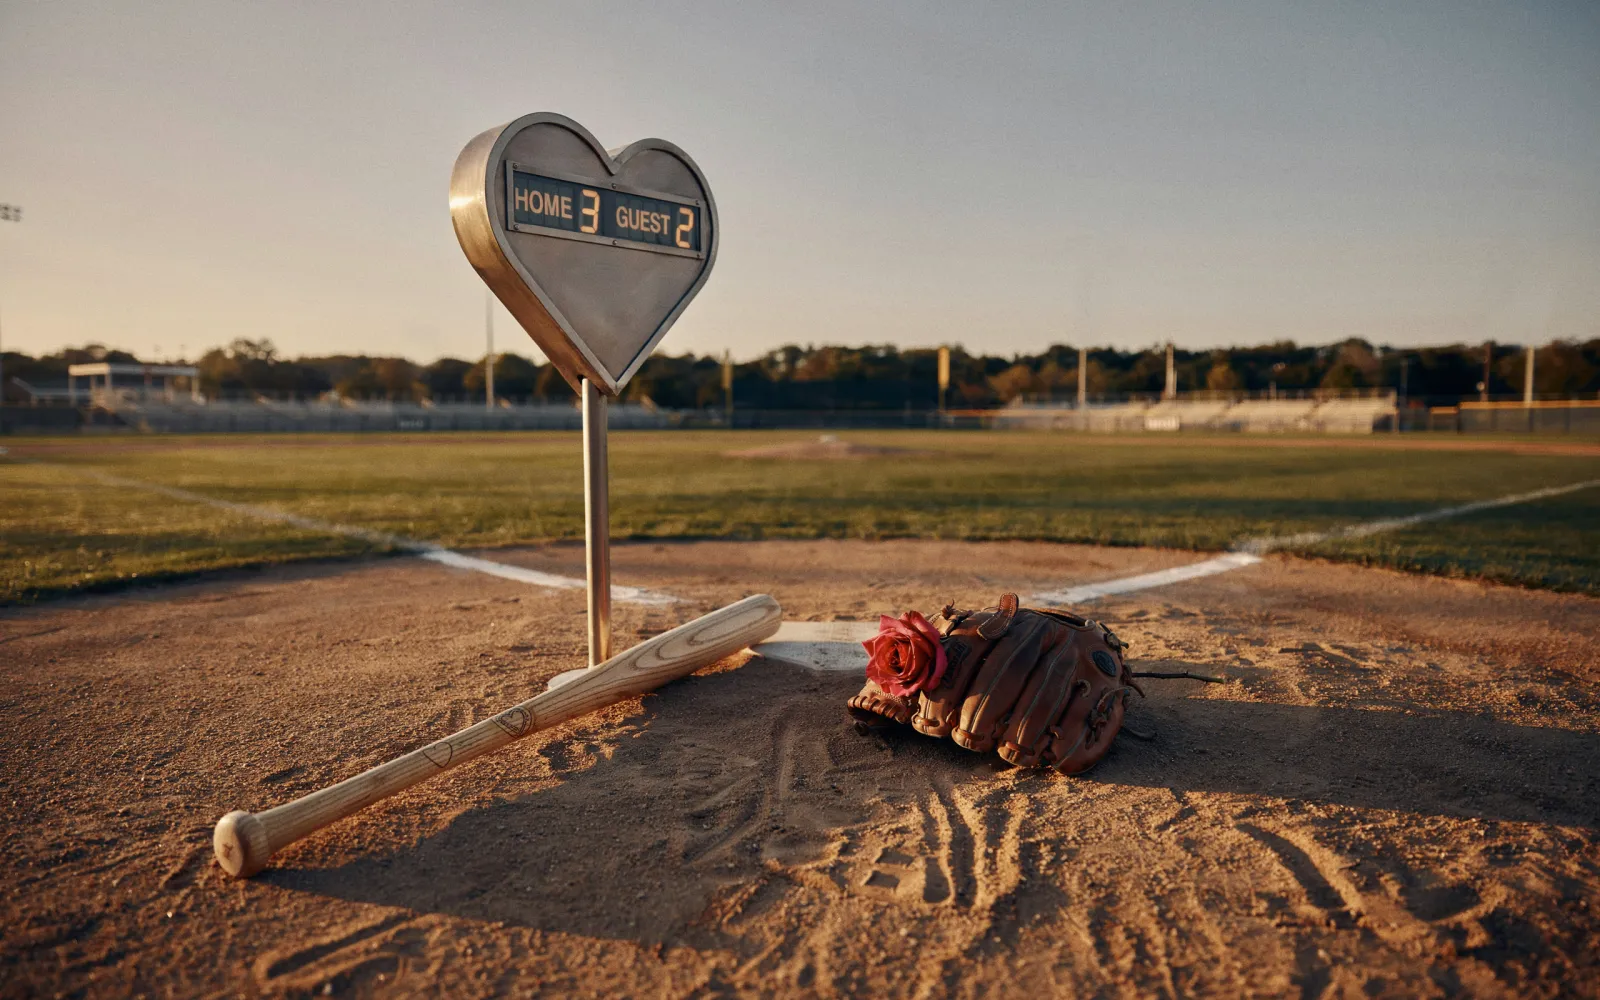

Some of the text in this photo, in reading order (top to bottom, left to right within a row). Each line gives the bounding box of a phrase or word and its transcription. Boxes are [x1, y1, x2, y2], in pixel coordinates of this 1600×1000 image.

[515, 188, 694, 248] HOME 3 GUEST 2
